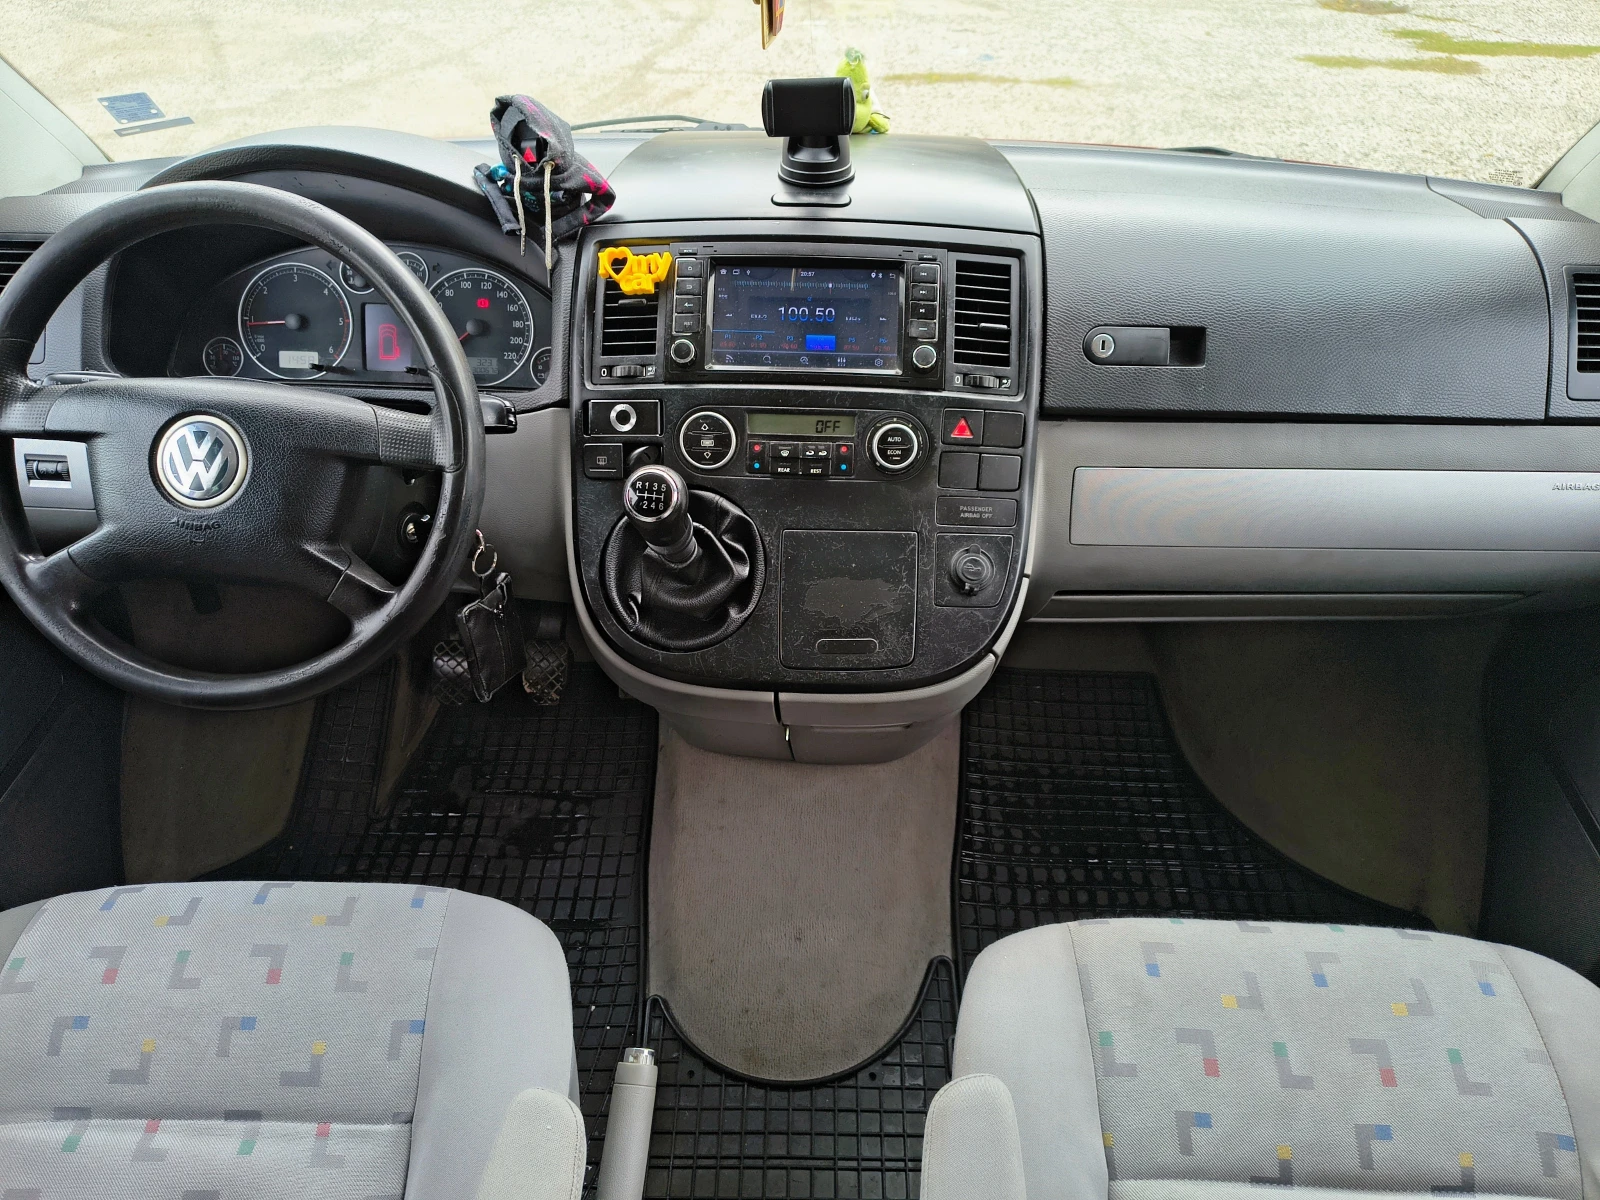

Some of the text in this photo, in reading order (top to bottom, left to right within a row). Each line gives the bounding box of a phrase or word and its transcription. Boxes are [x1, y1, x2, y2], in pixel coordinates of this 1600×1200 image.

[631, 251, 673, 282] my
[620, 273, 655, 295] car
[507, 304, 518, 312] 160
[779, 307, 835, 322] 100.50
[504, 352, 517, 360] 220
[601, 368, 608, 377] 0
[954, 376, 961, 384] 0
[815, 420, 841, 433] OFF
[636, 481, 642, 489] R
[652, 483, 658, 491] 3
[642, 501, 648, 509] 2
[650, 502, 656, 510] 4
